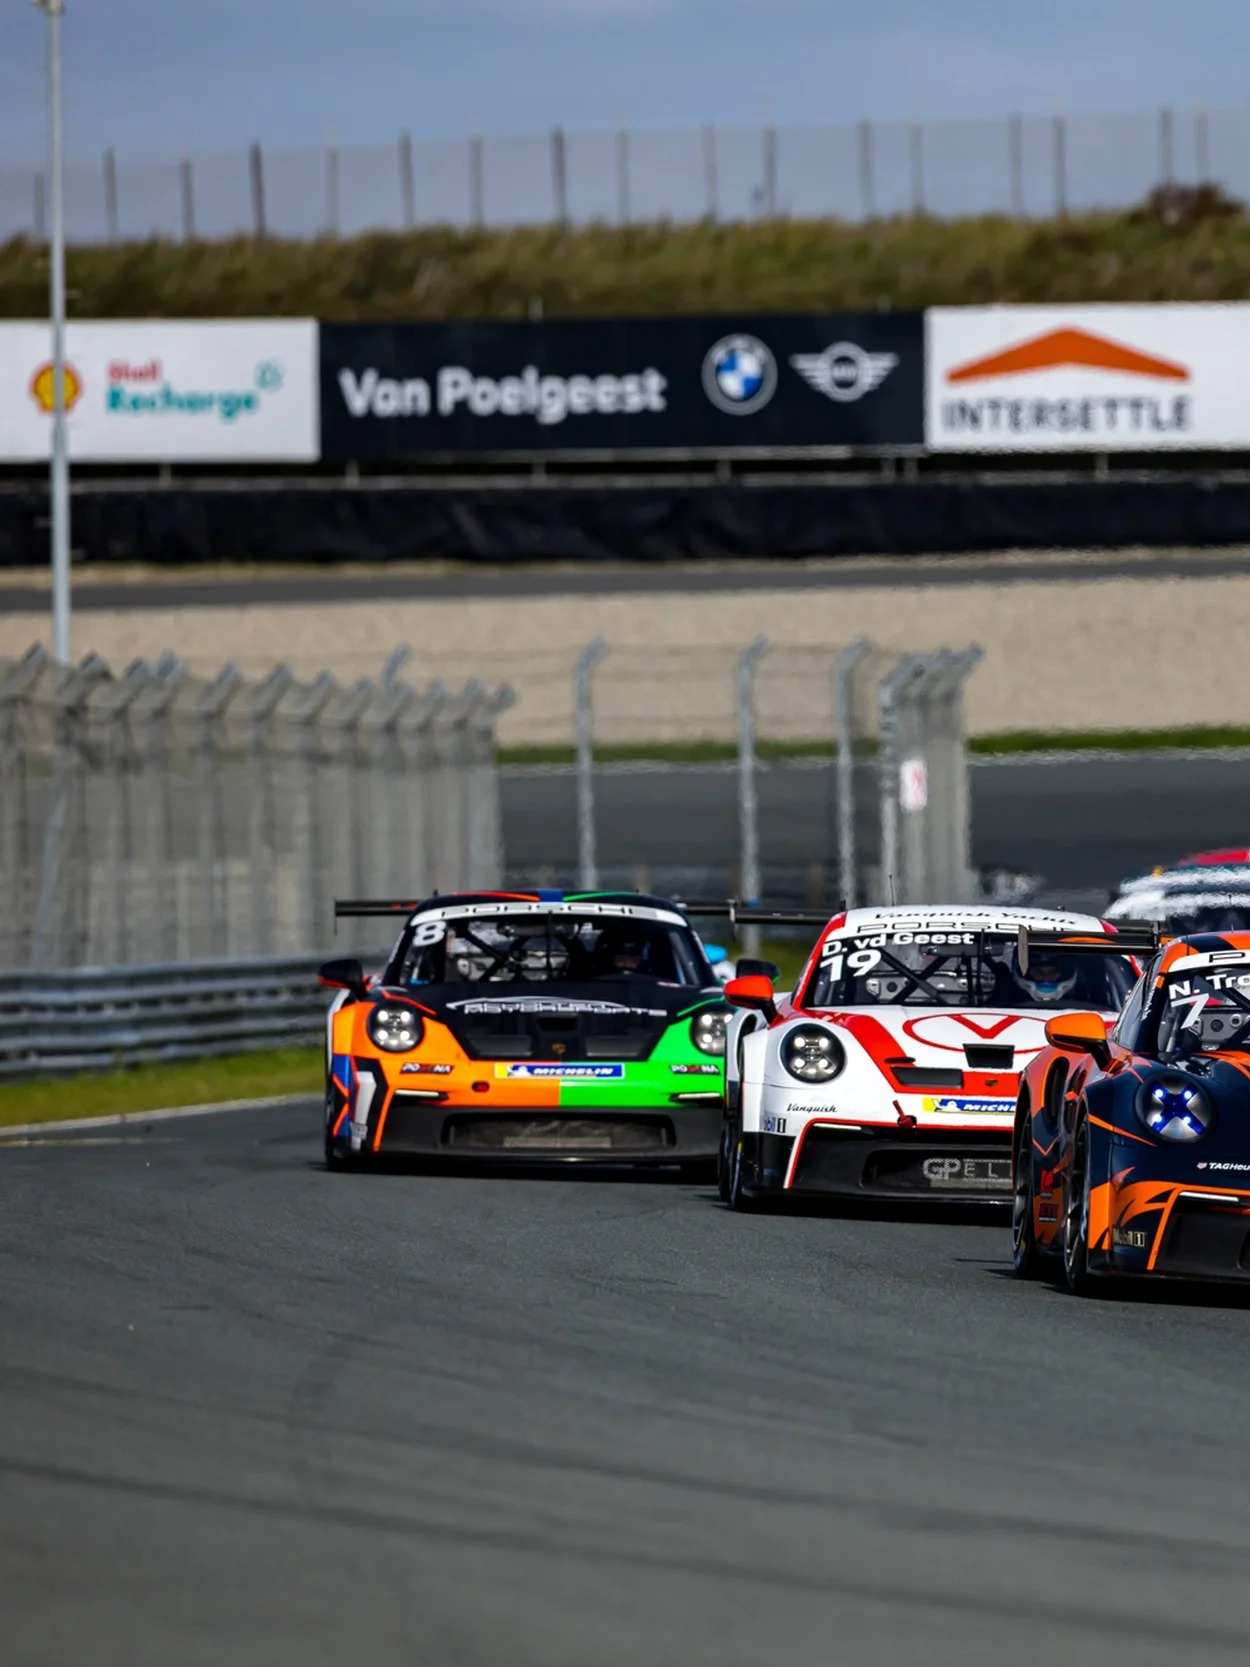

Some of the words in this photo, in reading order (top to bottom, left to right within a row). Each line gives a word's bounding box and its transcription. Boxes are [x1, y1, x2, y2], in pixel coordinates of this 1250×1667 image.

[340, 368, 430, 418] Van
[438, 365, 667, 424] Poelgeest
[942, 395, 1193, 433] INTERSETTLE
[413, 920, 447, 947] 8
[822, 941, 848, 956] D.
[854, 933, 886, 949] vd
[893, 932, 975, 945] Geest
[820, 950, 882, 983] 19
[1168, 980, 1200, 1000] N.
[1170, 993, 1210, 1030] 7
[533, 1066, 614, 1076] MICHELIN
[787, 1103, 838, 1113] Vanquish
[963, 1103, 1016, 1112] MICH
